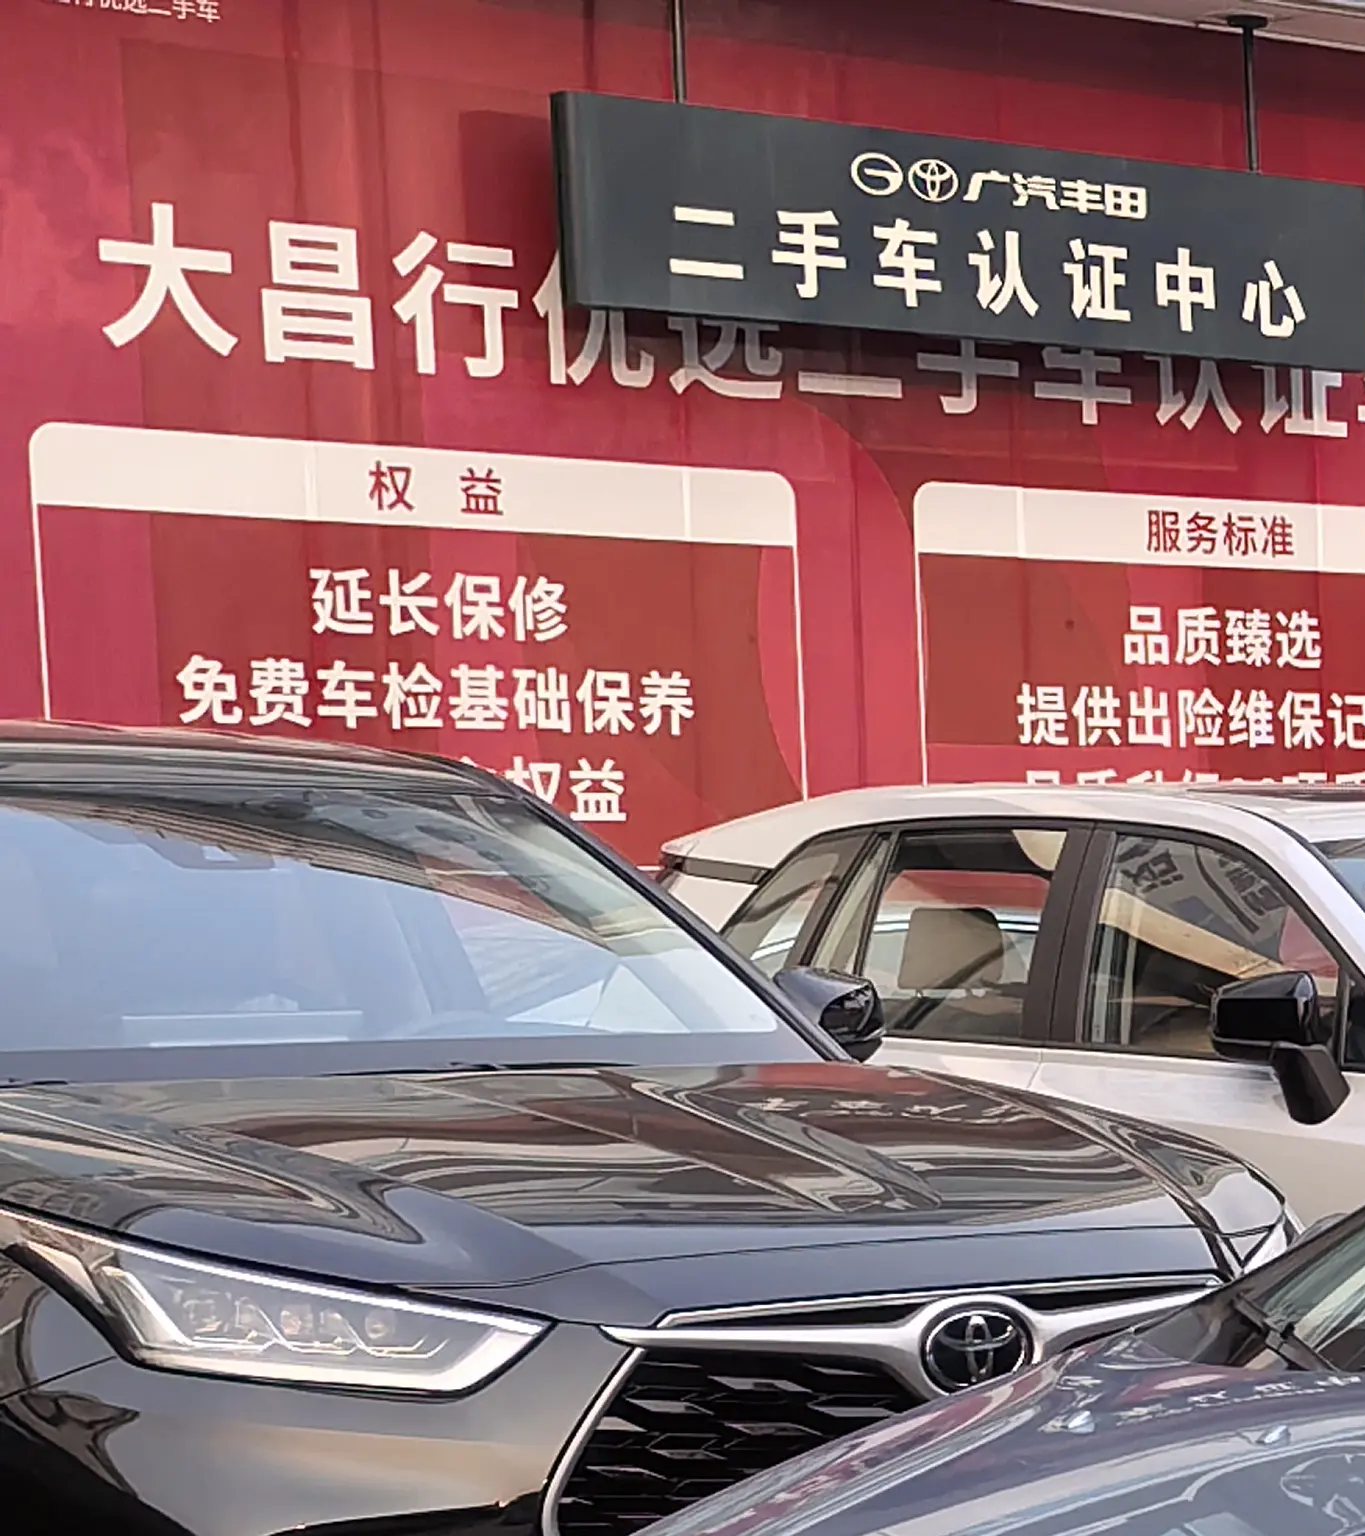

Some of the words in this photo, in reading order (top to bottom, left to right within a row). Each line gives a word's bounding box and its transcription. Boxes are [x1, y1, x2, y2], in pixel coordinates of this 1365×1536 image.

[963, 169, 1147, 220] 广汽丰田
[669, 206, 1306, 338] 二手车认证中心
[368, 460, 505, 517] 权益
[1146, 509, 1296, 558] 服务标准
[309, 568, 569, 642] 延长保修
[1123, 605, 1322, 669] 品质臻选
[176, 654, 695, 736] 免费车检基础保养
